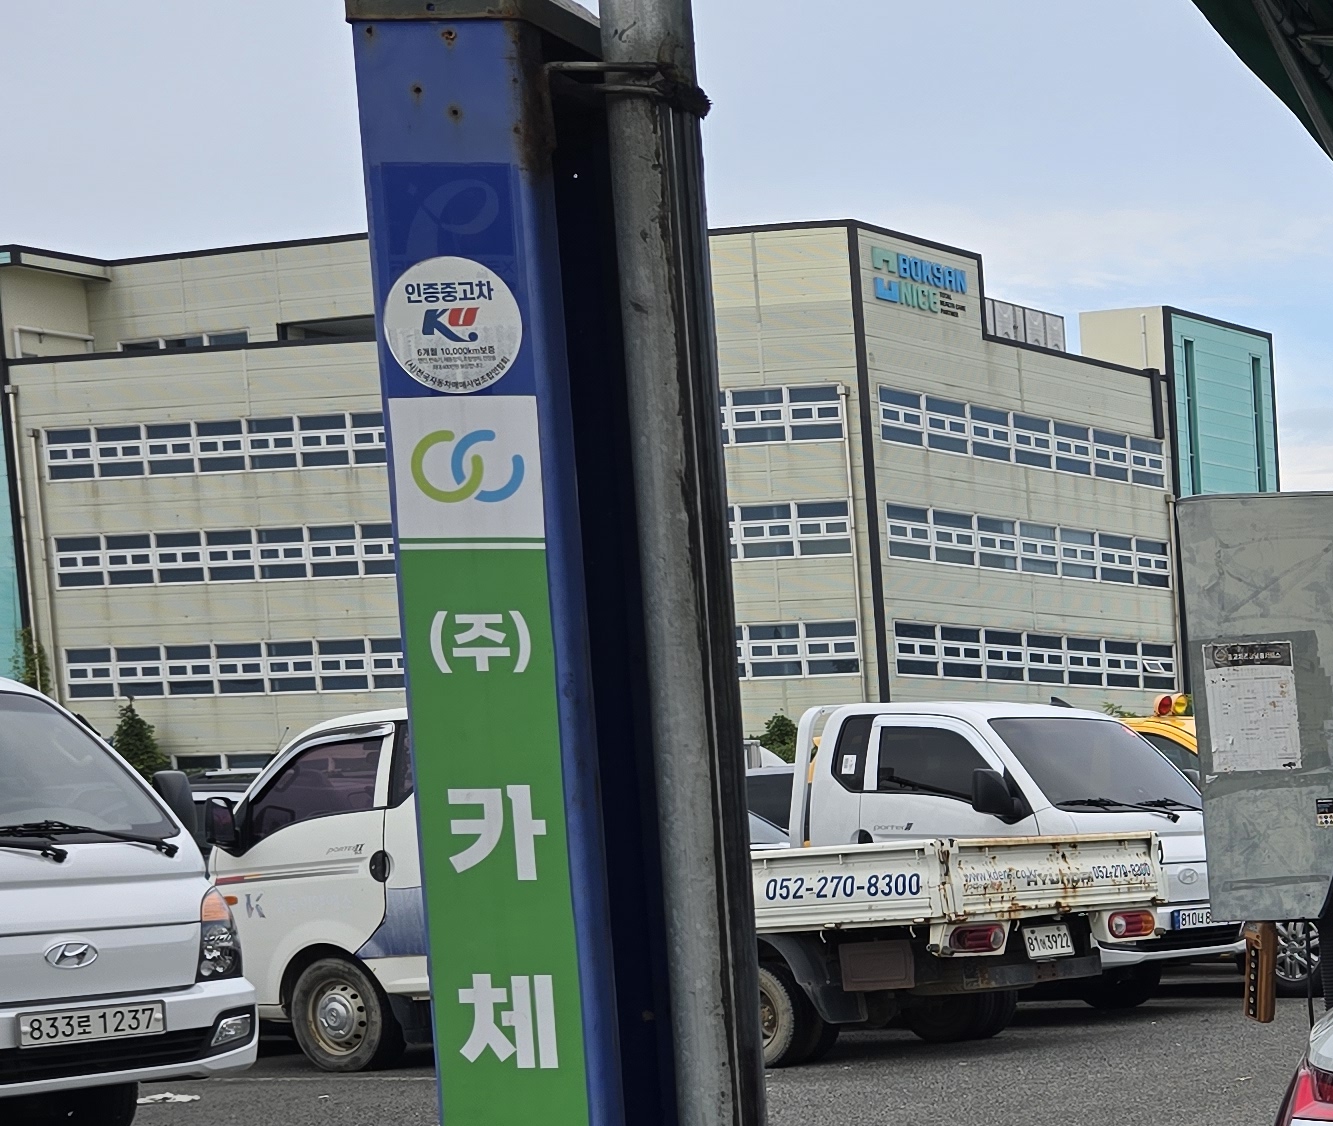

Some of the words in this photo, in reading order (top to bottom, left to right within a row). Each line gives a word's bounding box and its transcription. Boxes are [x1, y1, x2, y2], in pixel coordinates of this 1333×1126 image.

[898, 253, 966, 294] BOKSAN
[405, 280, 494, 303] 인증중고차
[900, 280, 939, 314] NICE
[429, 610, 532, 674] (주)
[765, 872, 922, 901] 052-270-8300
[29, 1014, 92, 1040] 833로
[98, 1007, 155, 1034] 1237
